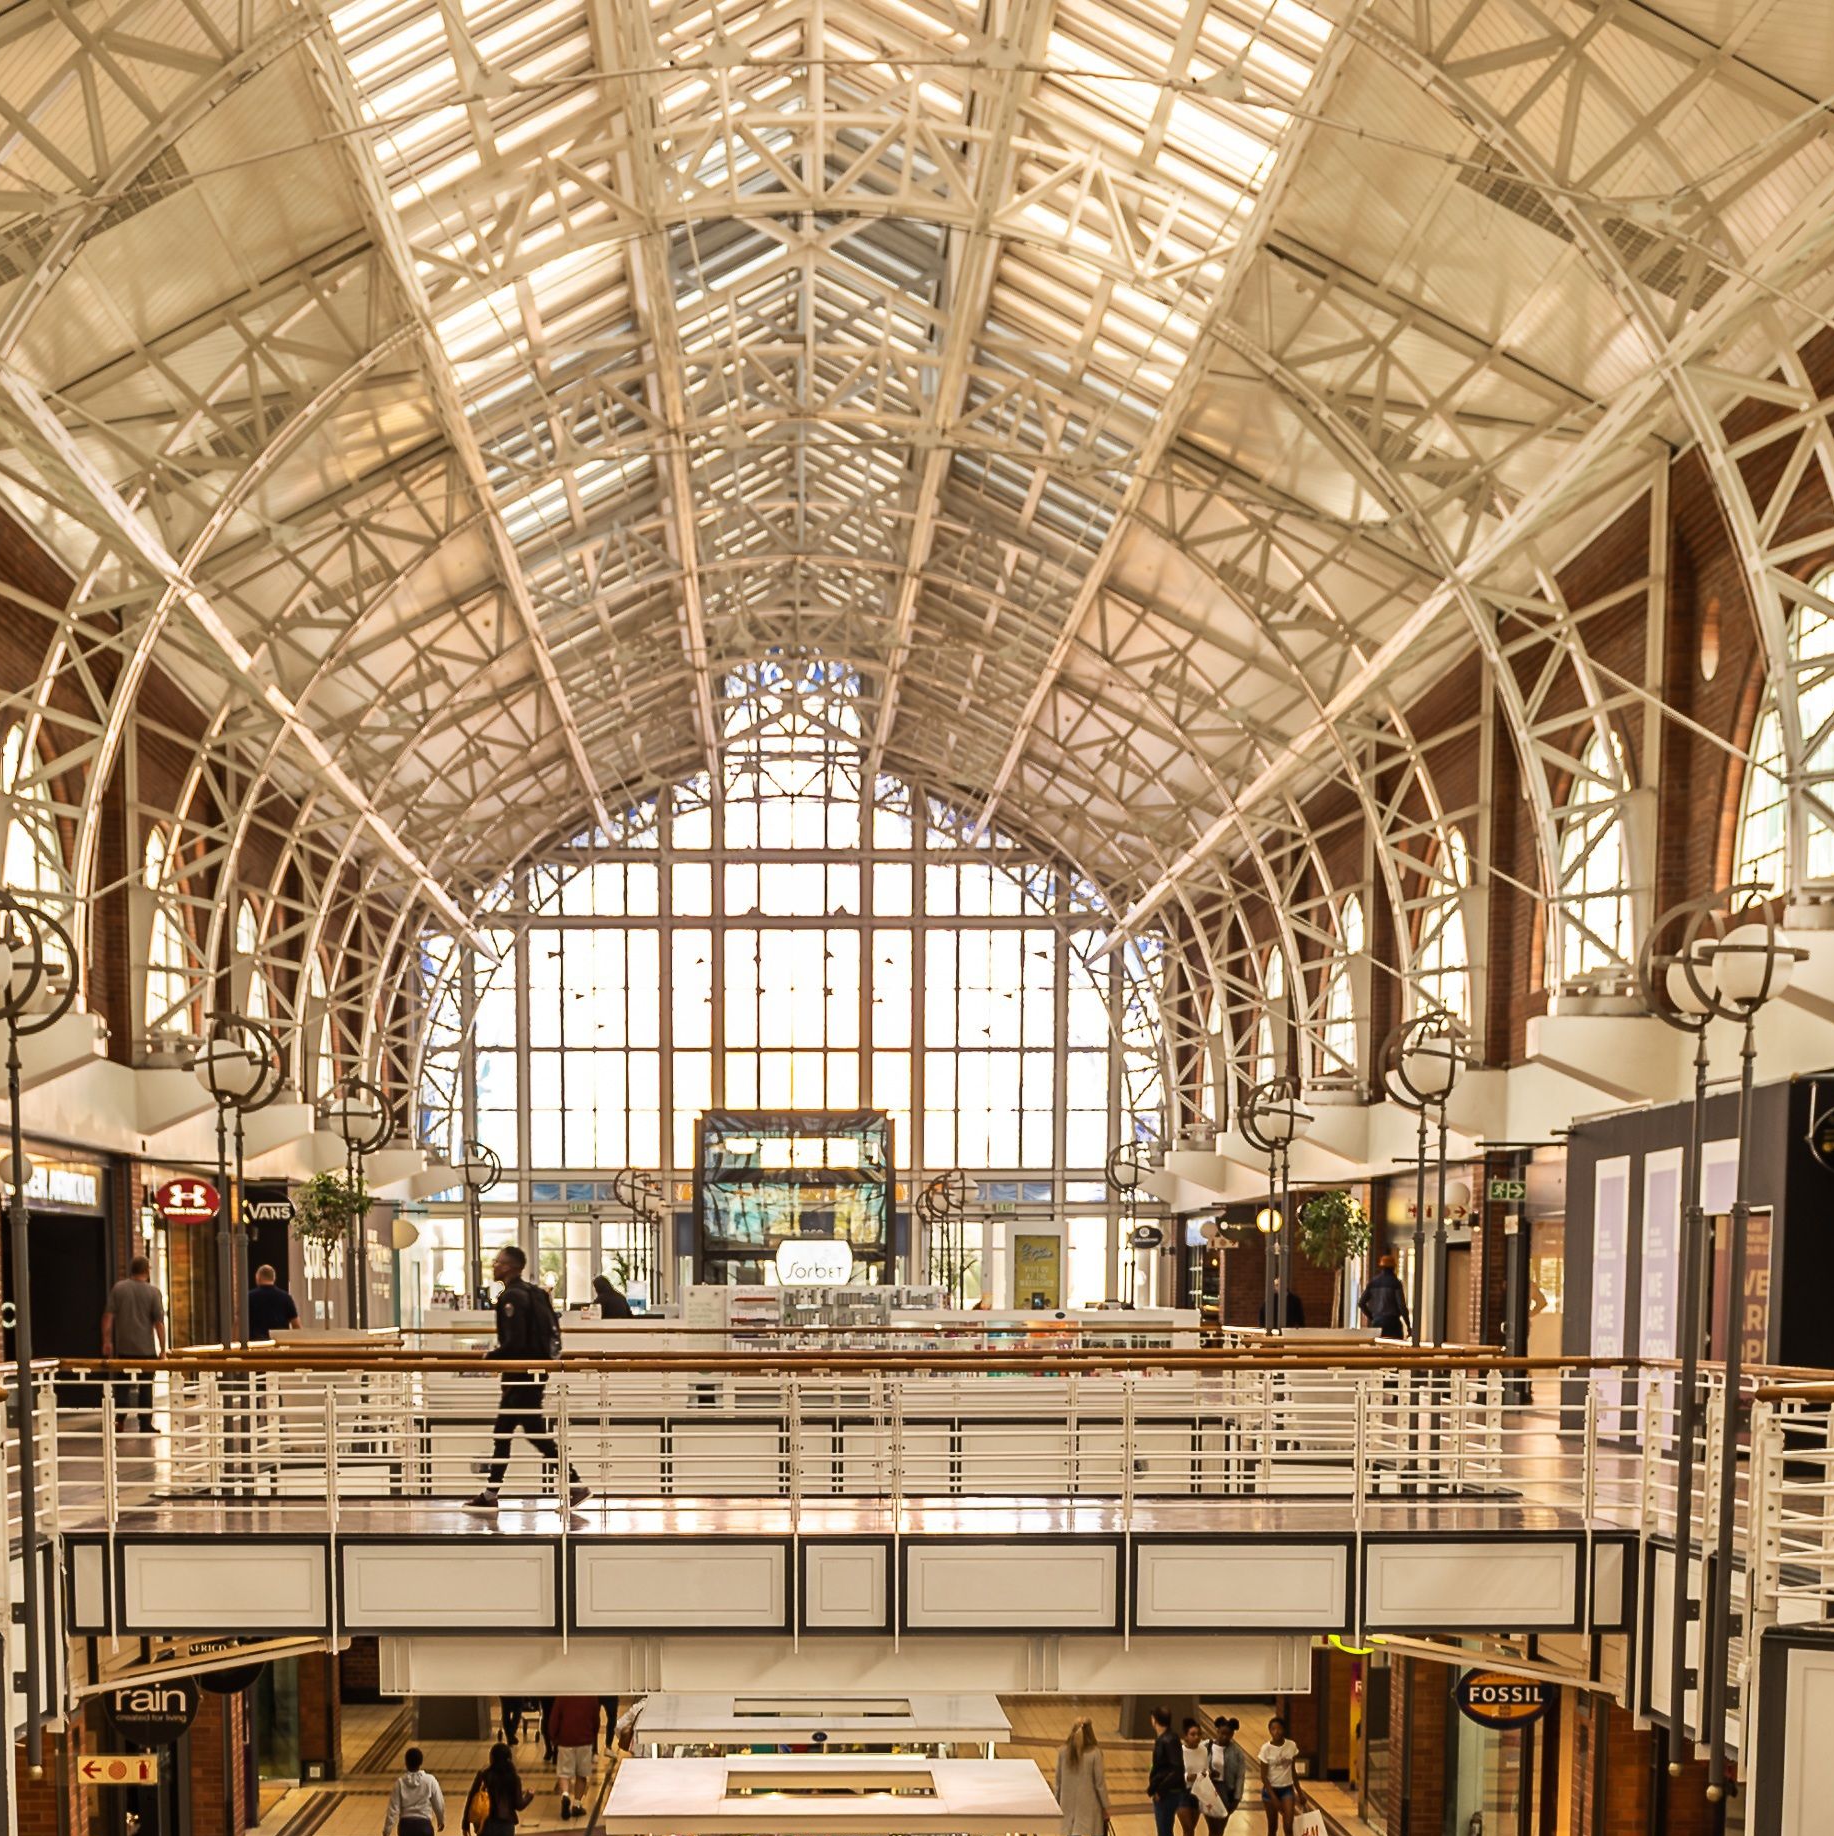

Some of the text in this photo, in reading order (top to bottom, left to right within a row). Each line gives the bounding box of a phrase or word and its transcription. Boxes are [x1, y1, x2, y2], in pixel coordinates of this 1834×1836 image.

[249, 1202, 291, 1220] VANS
[115, 1683, 186, 1712] rain
[1469, 1687, 1543, 1702] FOSSIL
